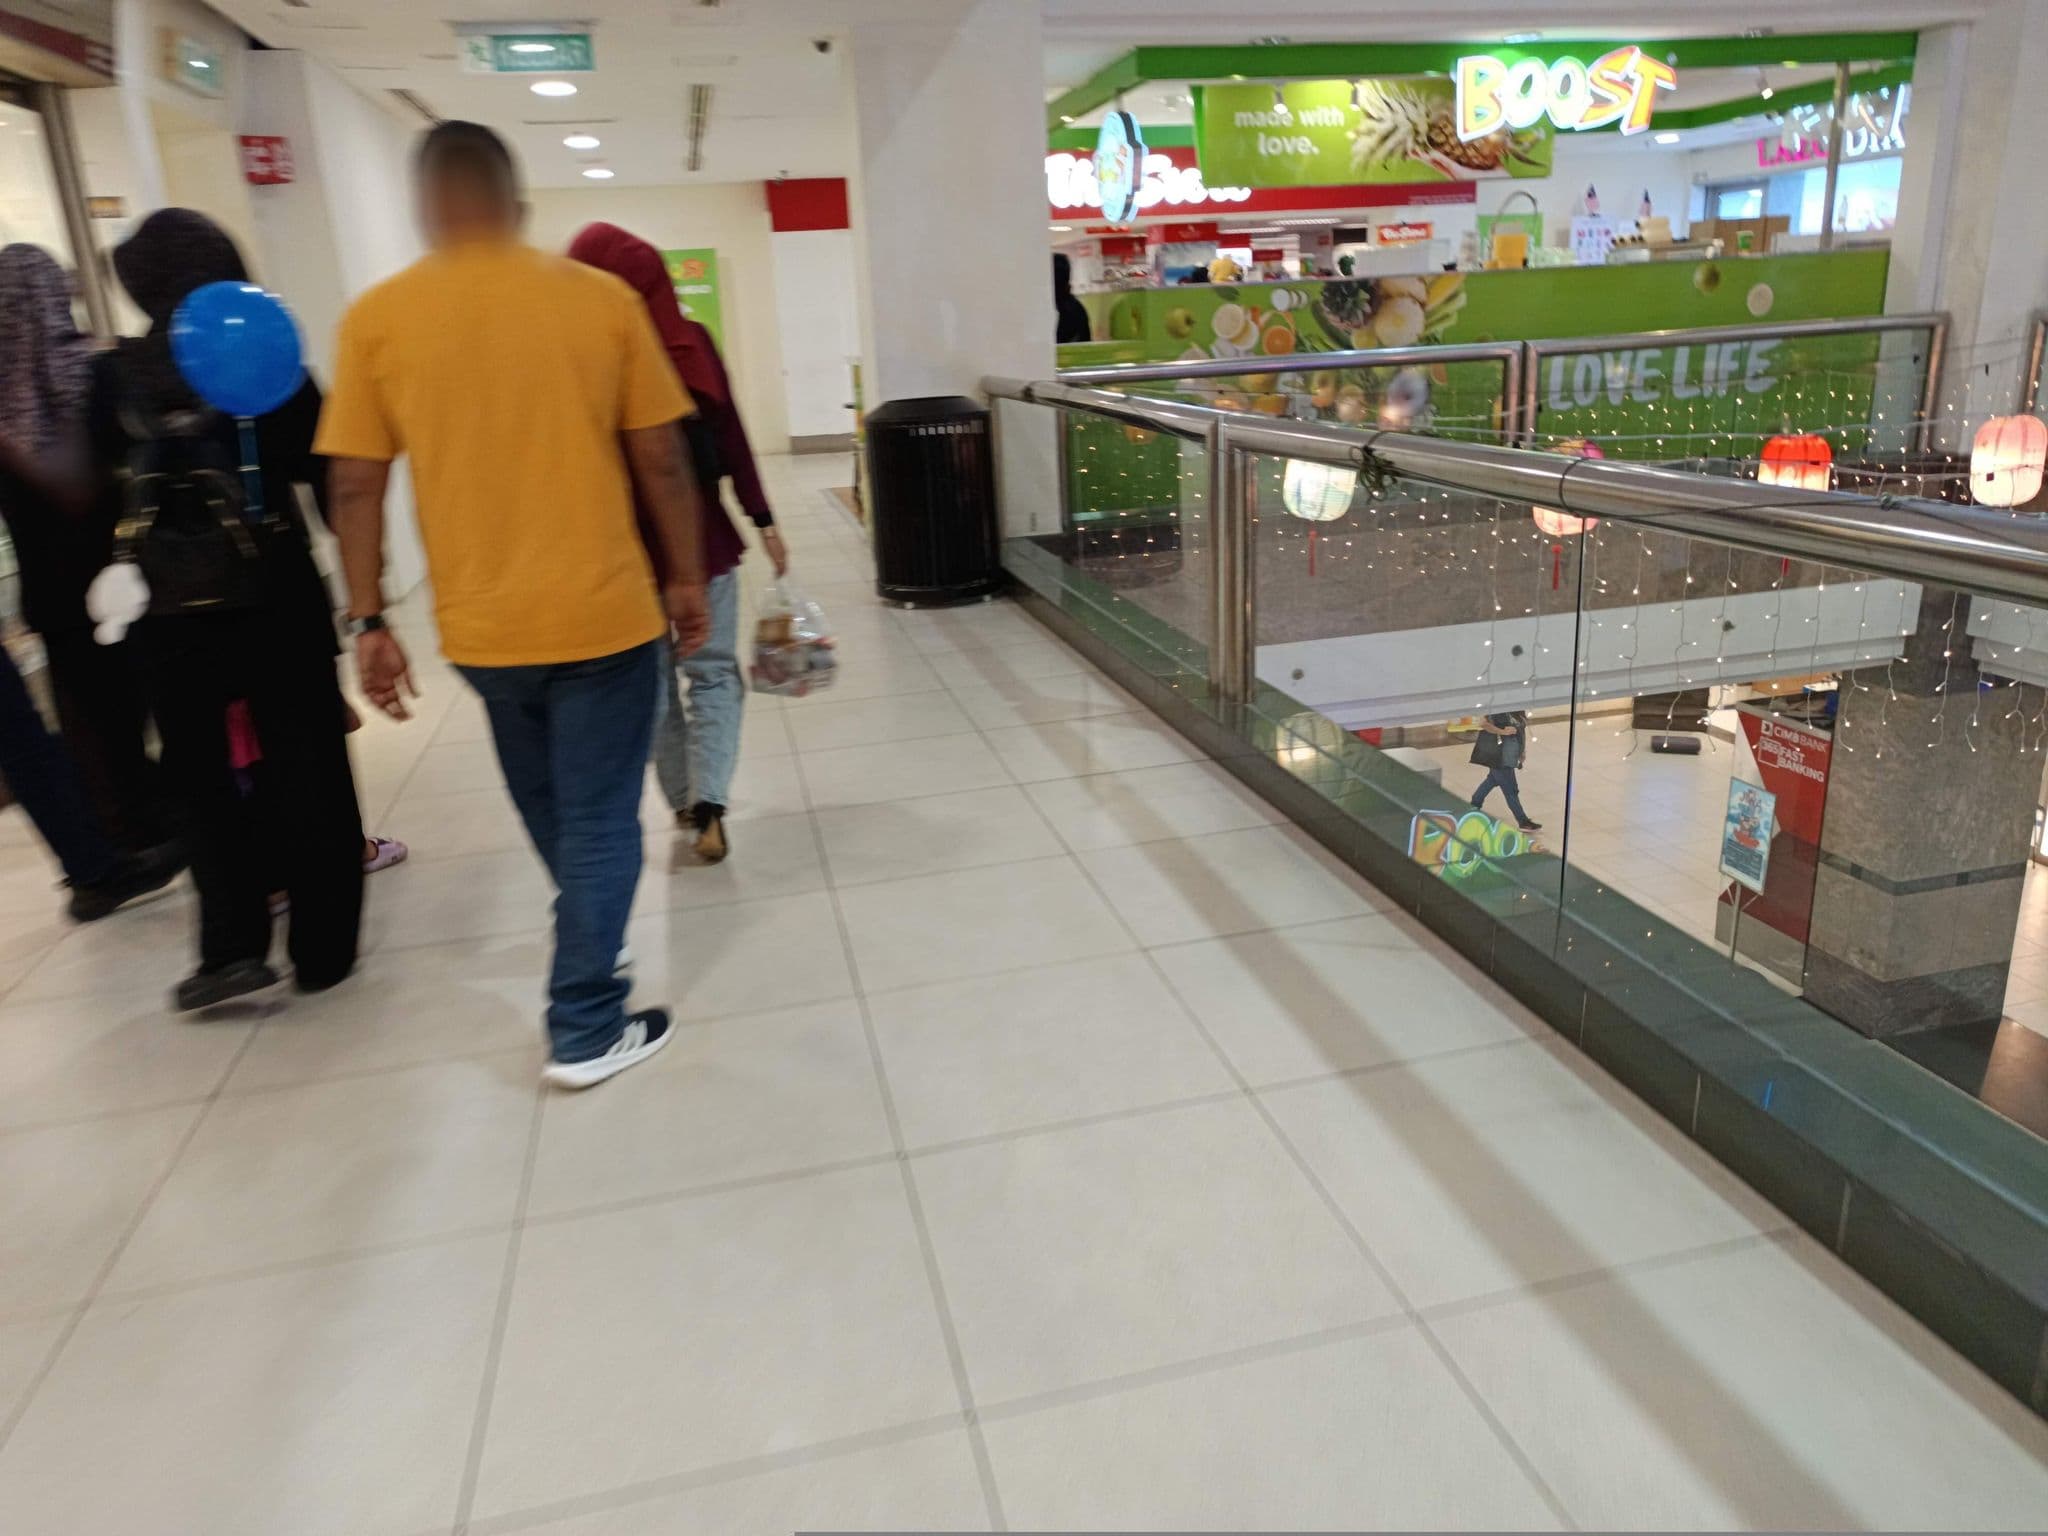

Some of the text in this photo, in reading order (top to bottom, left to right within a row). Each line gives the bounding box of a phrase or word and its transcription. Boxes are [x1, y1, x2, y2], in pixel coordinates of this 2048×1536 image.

[1457, 46, 1676, 142] BOOST
[1234, 104, 1345, 127] made with
[1258, 132, 1320, 156] love.
[1549, 339, 1783, 410] LOVE LIFE
[1779, 744, 1805, 763] FAST
[1777, 757, 1825, 782] BANKING
